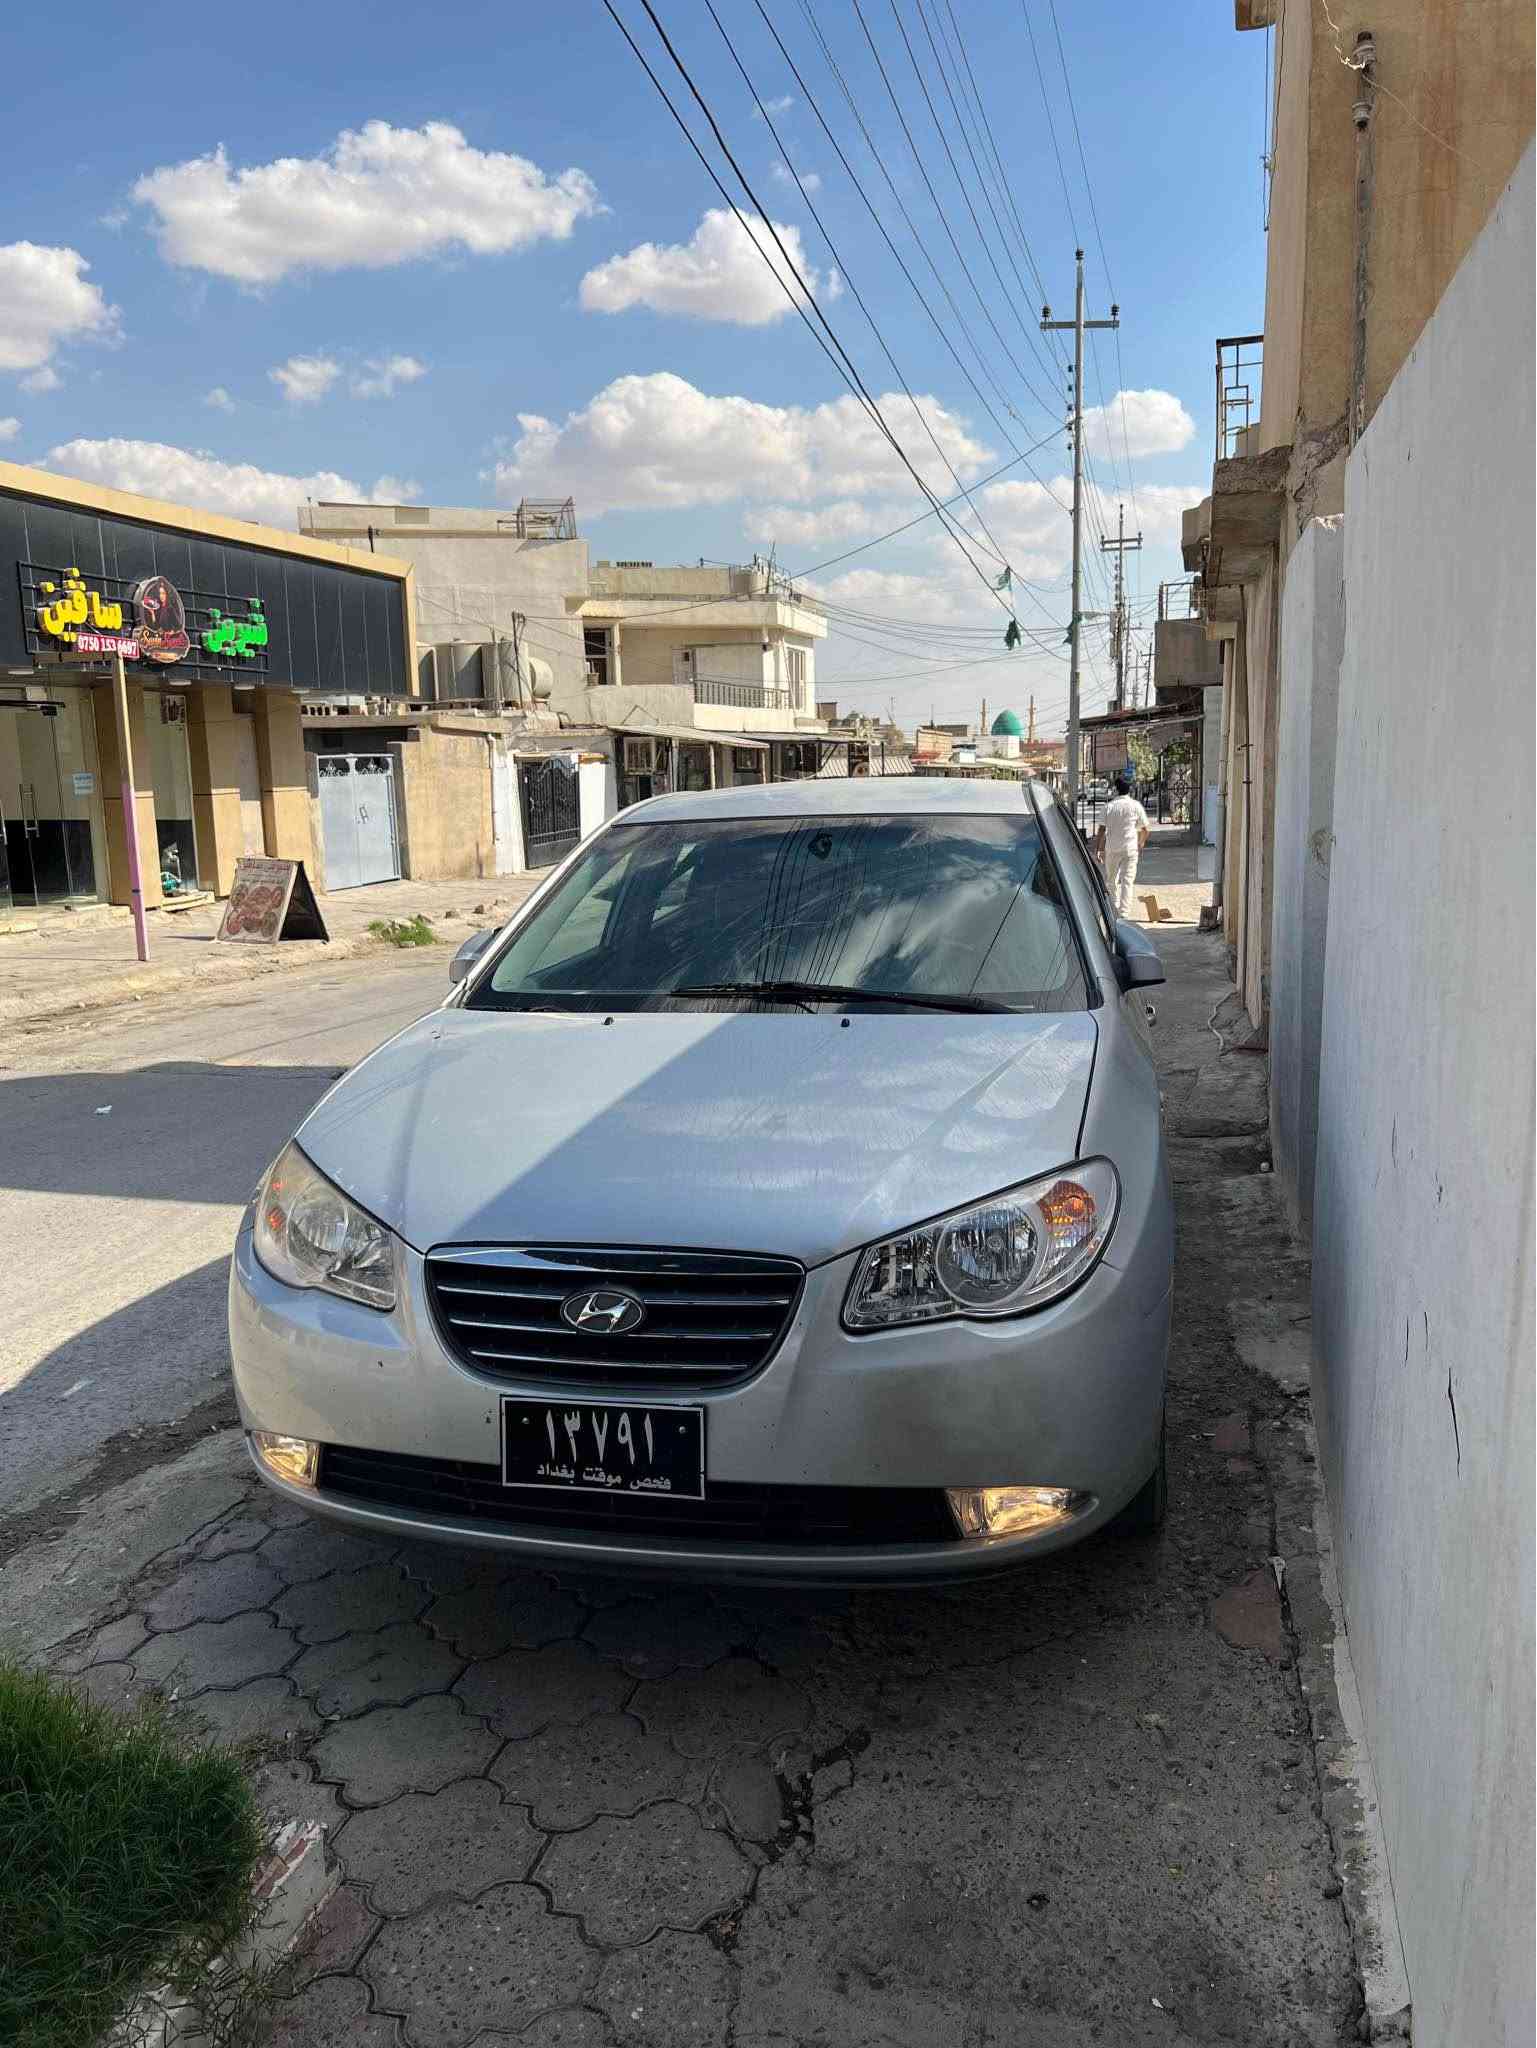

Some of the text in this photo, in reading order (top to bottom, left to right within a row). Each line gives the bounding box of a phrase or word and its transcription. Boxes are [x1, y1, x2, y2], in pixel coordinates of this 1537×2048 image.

[78, 634, 99, 651] 0750
[546, 1409, 654, 1465] ١٣٧٩١
[537, 1463, 672, 1490] فحص موقت بغداد
